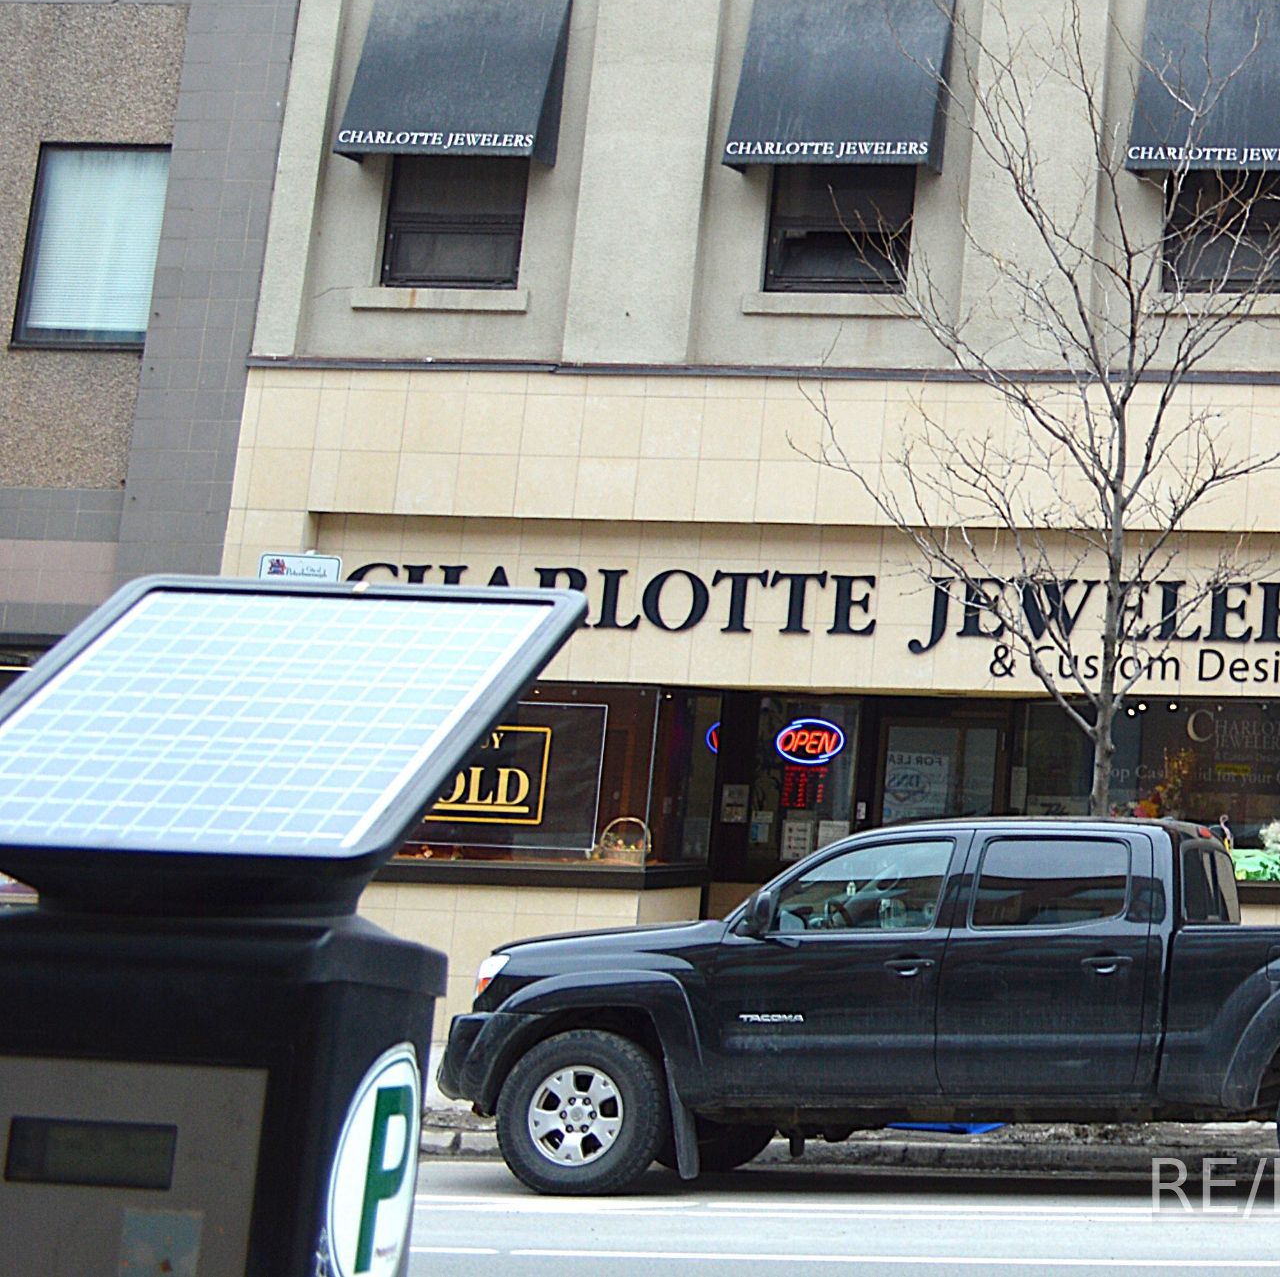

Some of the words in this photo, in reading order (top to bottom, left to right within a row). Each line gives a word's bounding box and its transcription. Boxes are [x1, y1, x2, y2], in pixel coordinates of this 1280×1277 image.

[337, 129, 443, 146] CHARLOTTE
[443, 131, 535, 150] JEWELERS
[725, 141, 834, 156] CHARLOTTE
[835, 141, 929, 159] JEWELERS
[1127, 146, 1238, 161] CHARLOTTE
[988, 645, 1017, 679] &
[779, 729, 839, 755] OPEN
[738, 1013, 805, 1023] TACOMA
[353, 1084, 414, 1276] P
